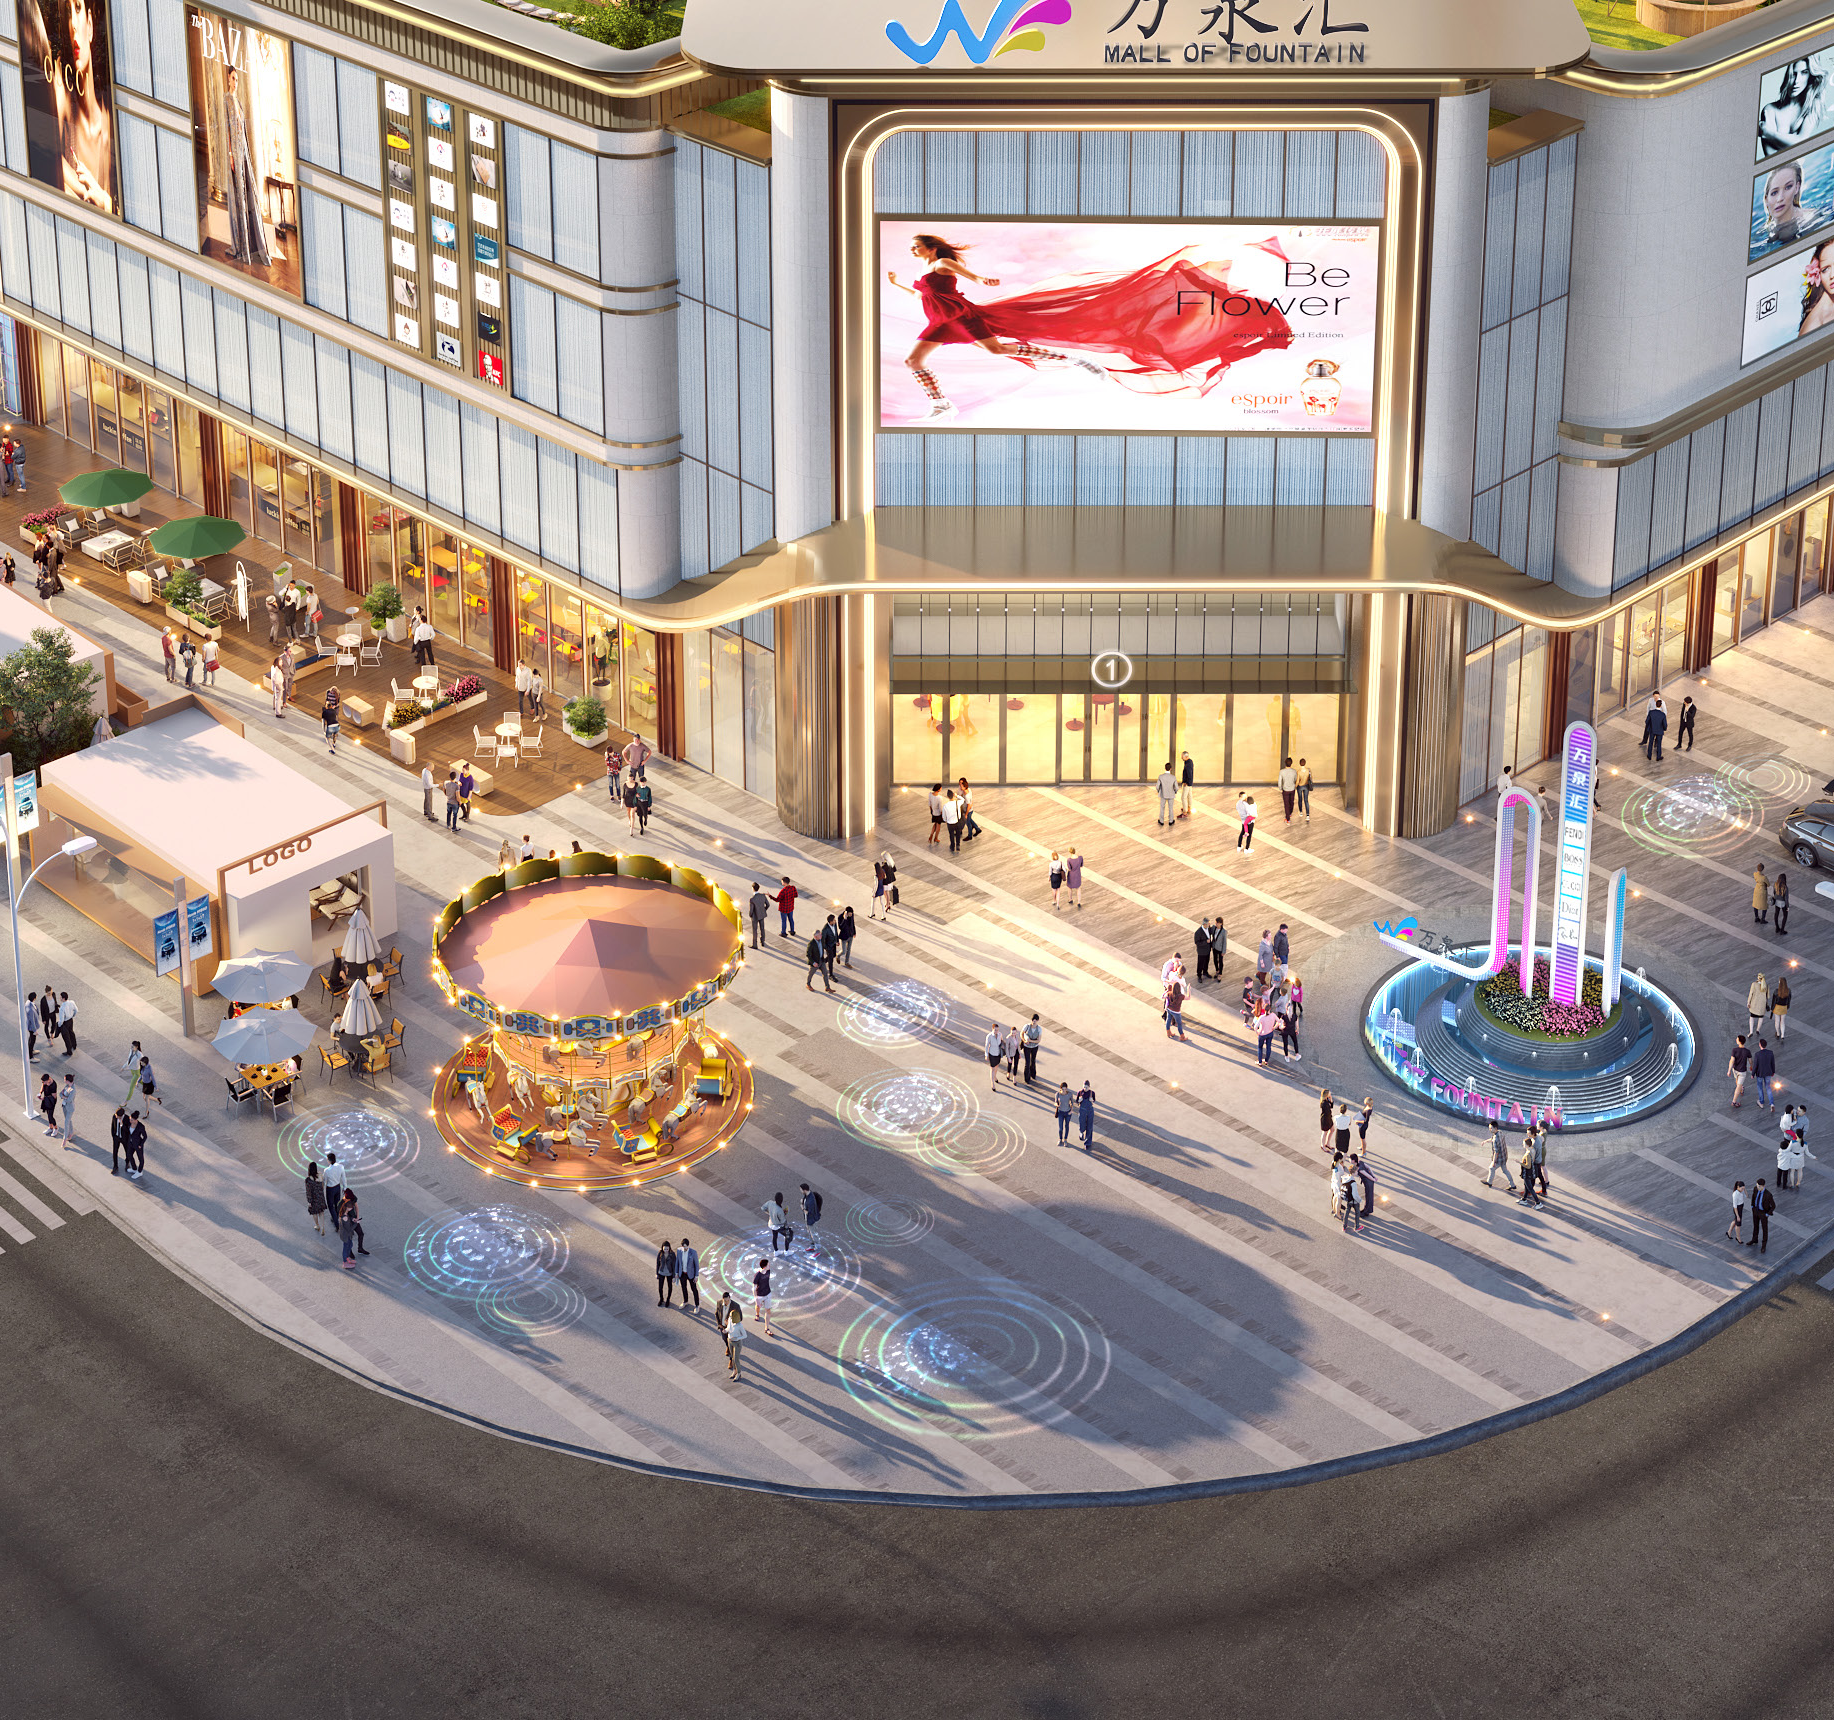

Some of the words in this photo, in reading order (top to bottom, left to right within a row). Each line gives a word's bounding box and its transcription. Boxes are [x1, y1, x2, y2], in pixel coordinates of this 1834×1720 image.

[1103, 43, 1171, 63] MALL
[1183, 43, 1217, 63] OF
[1228, 43, 1365, 63] FOUNTAIN
[1285, 262, 1351, 288] Be
[1177, 290, 1351, 316] Flower
[1308, 331, 1344, 339] Edition
[1105, 658, 1115, 681] 1
[1569, 747, 1588, 810] 万泉汇
[248, 836, 313, 876] LOGO
[1430, 1076, 1564, 1130] FOUNTAIN
